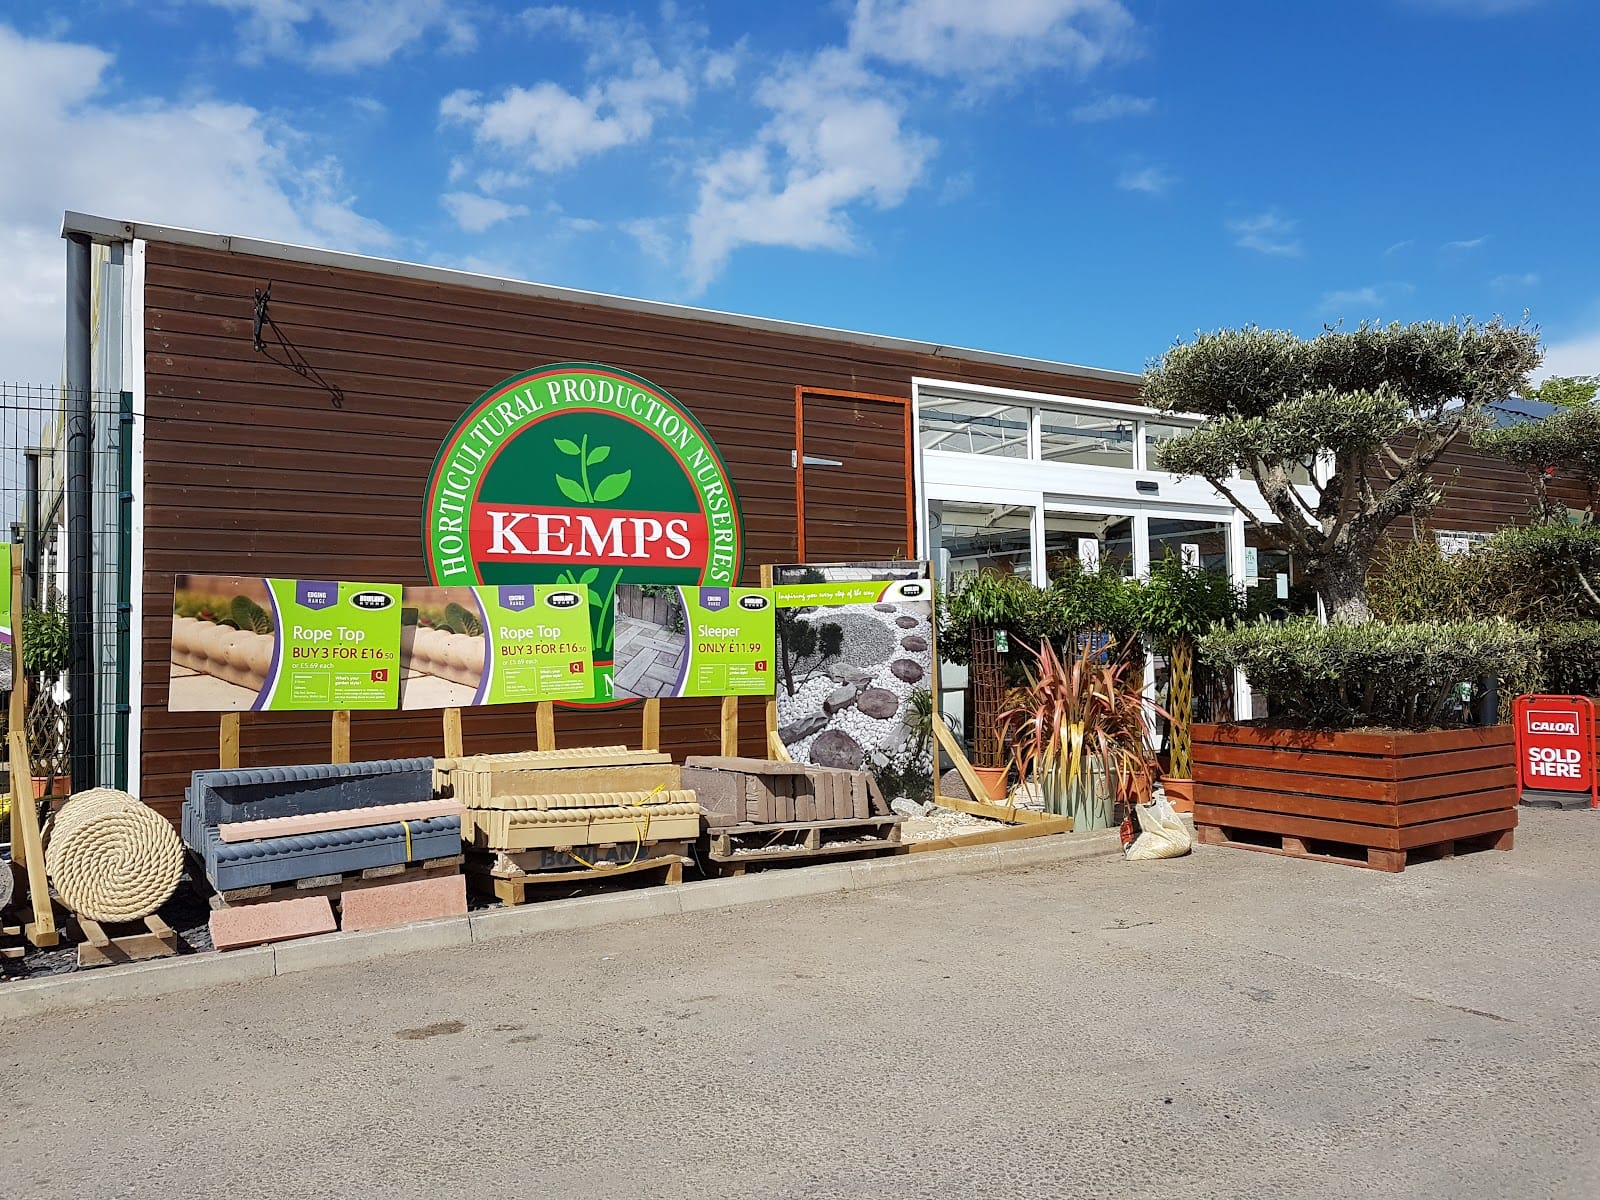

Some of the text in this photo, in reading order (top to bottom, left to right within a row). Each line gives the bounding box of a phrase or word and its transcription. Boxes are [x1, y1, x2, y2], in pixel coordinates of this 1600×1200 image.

[438, 378, 734, 582] HORTICULTURAL PRODUCTION NURSERIES
[486, 511, 691, 560] KEMPS
[307, 591, 327, 599] EDGING
[778, 591, 805, 601] Inspiring
[819, 592, 833, 600] every
[835, 590, 844, 598] step
[847, 588, 852, 599] of
[863, 590, 874, 598] way
[293, 625, 365, 645] Rope Top
[499, 624, 561, 642] Rope Top
[698, 624, 740, 640] Sleeper
[292, 647, 394, 659] BUY 3 FOR £16.50
[501, 645, 524, 656] BUY
[526, 644, 533, 655] 3
[535, 644, 556, 654] FOR
[698, 643, 761, 653] ONLY £11.99
[573, 663, 580, 672] Q
[375, 671, 383, 681] Q
[1531, 721, 1575, 734] CALOR
[1528, 747, 1581, 763] SOLD
[1530, 761, 1582, 778] HERE
